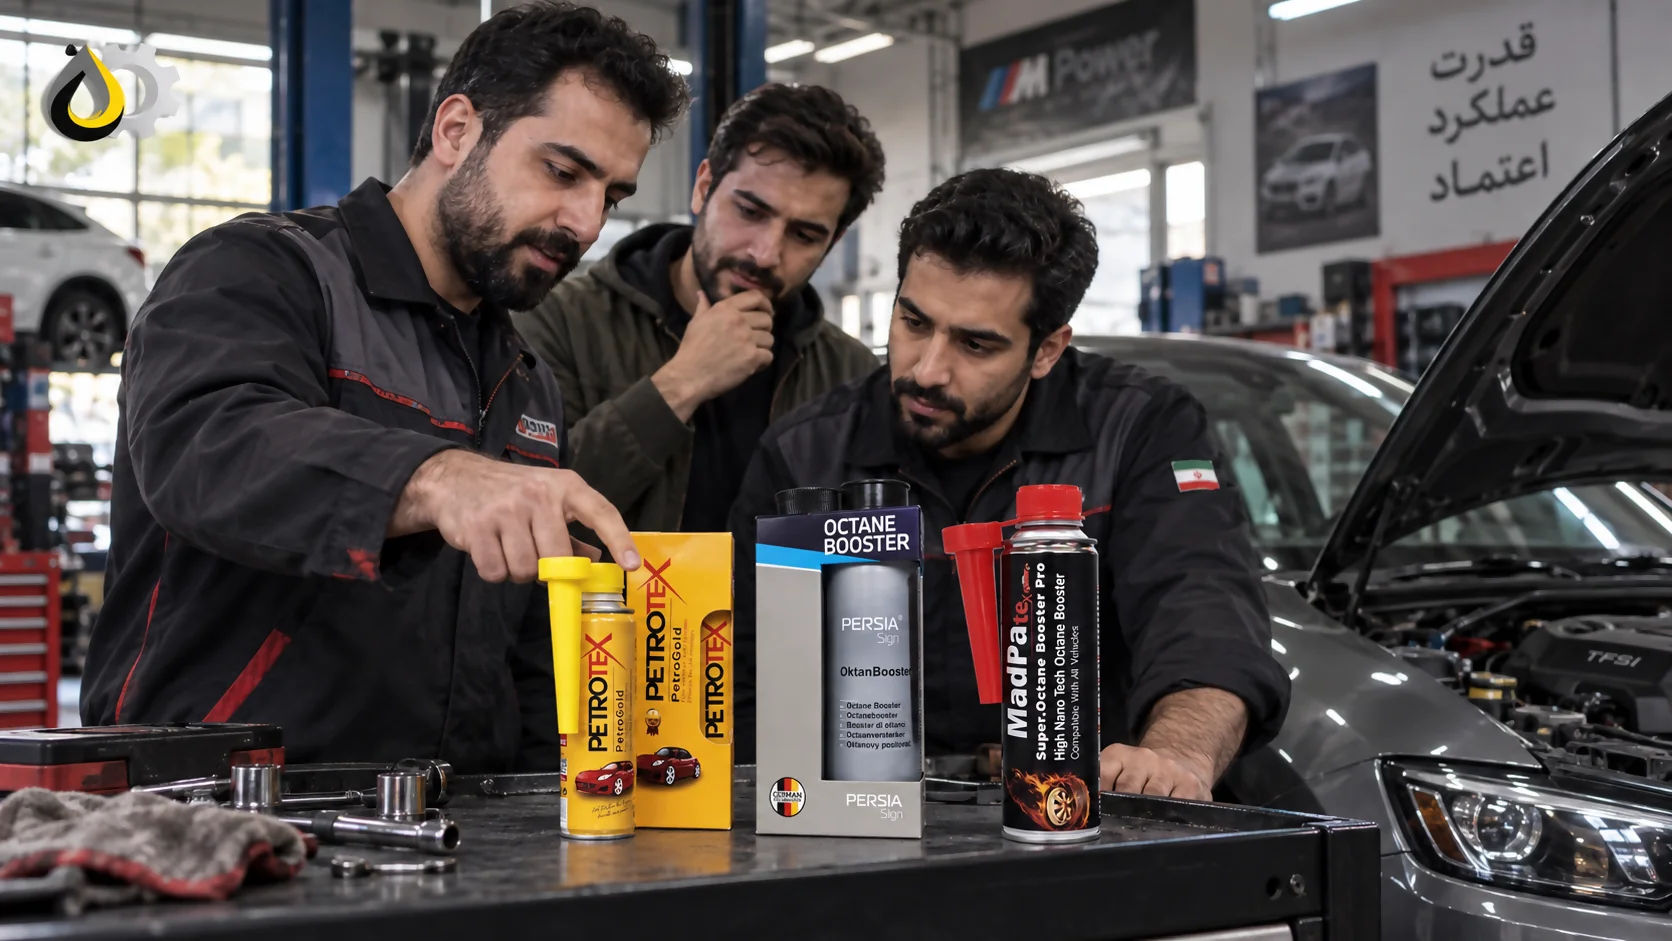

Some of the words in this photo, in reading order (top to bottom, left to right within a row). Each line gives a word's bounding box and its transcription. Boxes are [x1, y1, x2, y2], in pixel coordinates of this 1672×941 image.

[1054, 28, 1159, 93] Power
[1430, 21, 1537, 83] قدرت
[1428, 85, 1556, 145] عملکرد
[1429, 138, 1548, 202] اعتماد
[824, 514, 897, 537] OCTANE
[824, 533, 911, 556] BOOSTER
[1035, 562, 1046, 588] Pro
[1053, 573, 1066, 620] Booster
[637, 558, 687, 702] PETROTEX
[876, 632, 900, 647] Sign
[1035, 593, 1046, 653] Booster
[1053, 624, 1066, 667] Octane
[1587, 649, 1642, 668] TFSI
[671, 627, 682, 703] PetroGold
[700, 620, 732, 739] PETROTEX
[1053, 670, 1066, 697] Tech
[580, 632, 627, 752] PETROTEX
[846, 702, 872, 710] Octane
[1070, 682, 1079, 703] With
[615, 690, 625, 752] PetroGold
[1053, 699, 1066, 731] Nano
[1053, 733, 1068, 761] High
[846, 793, 903, 808] PERSIA
[880, 808, 903, 821] Sign
